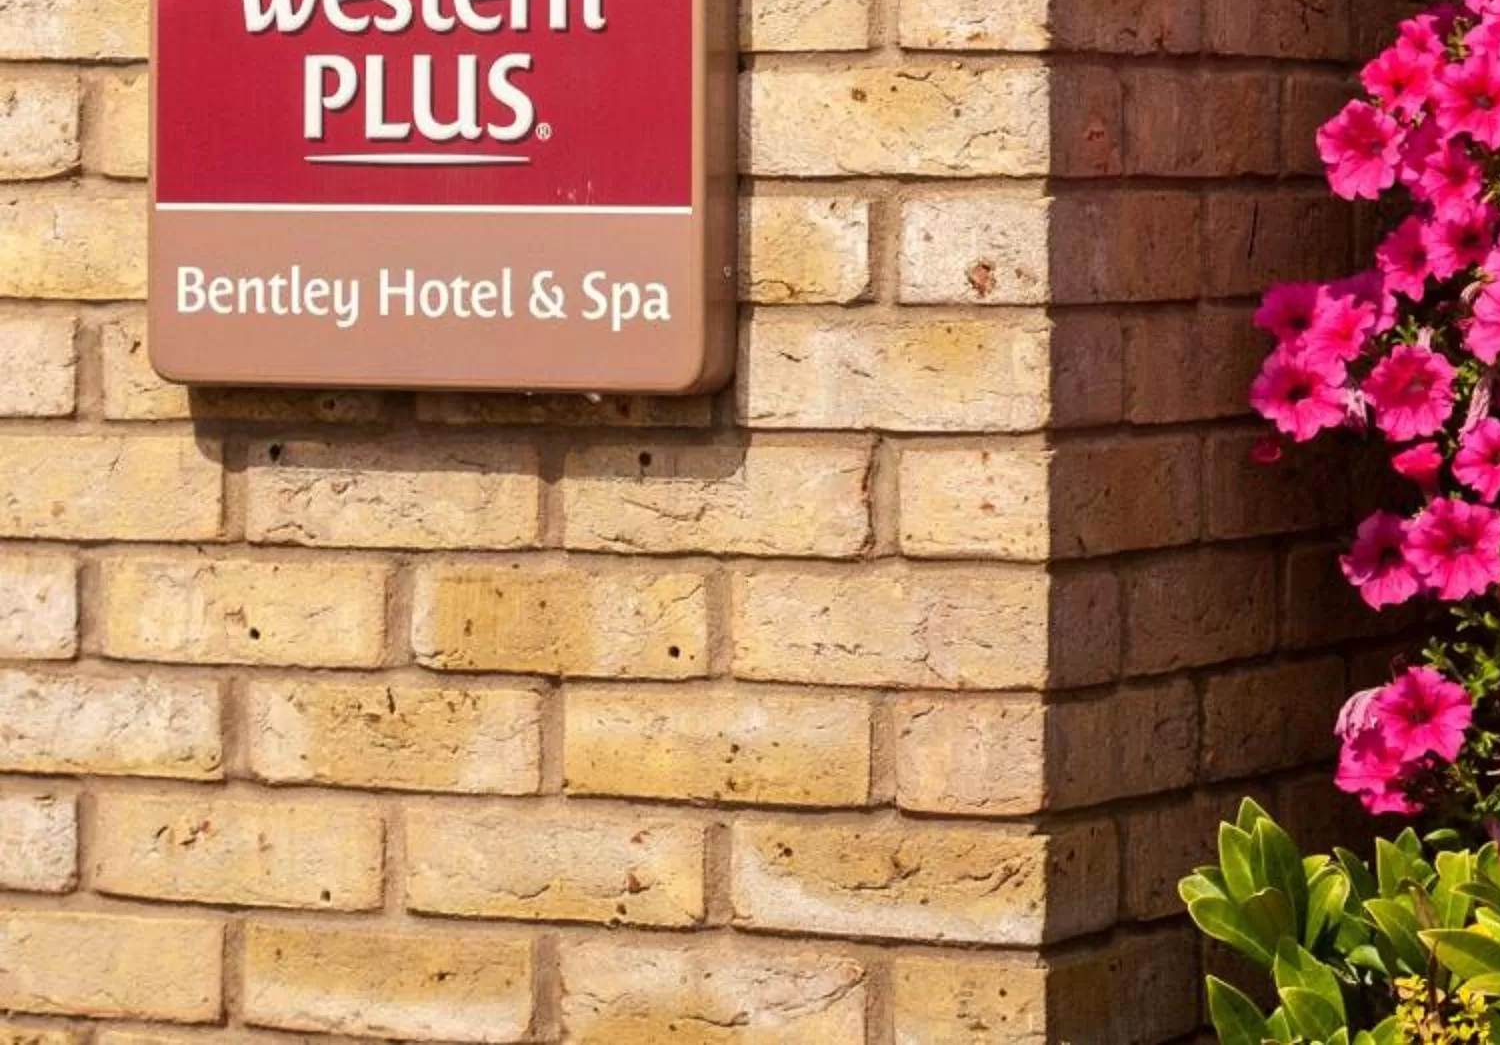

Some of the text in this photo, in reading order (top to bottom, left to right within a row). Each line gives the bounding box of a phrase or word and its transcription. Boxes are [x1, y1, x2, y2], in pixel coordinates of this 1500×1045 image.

[176, 265, 672, 333] Bentley Hotel & Spa
